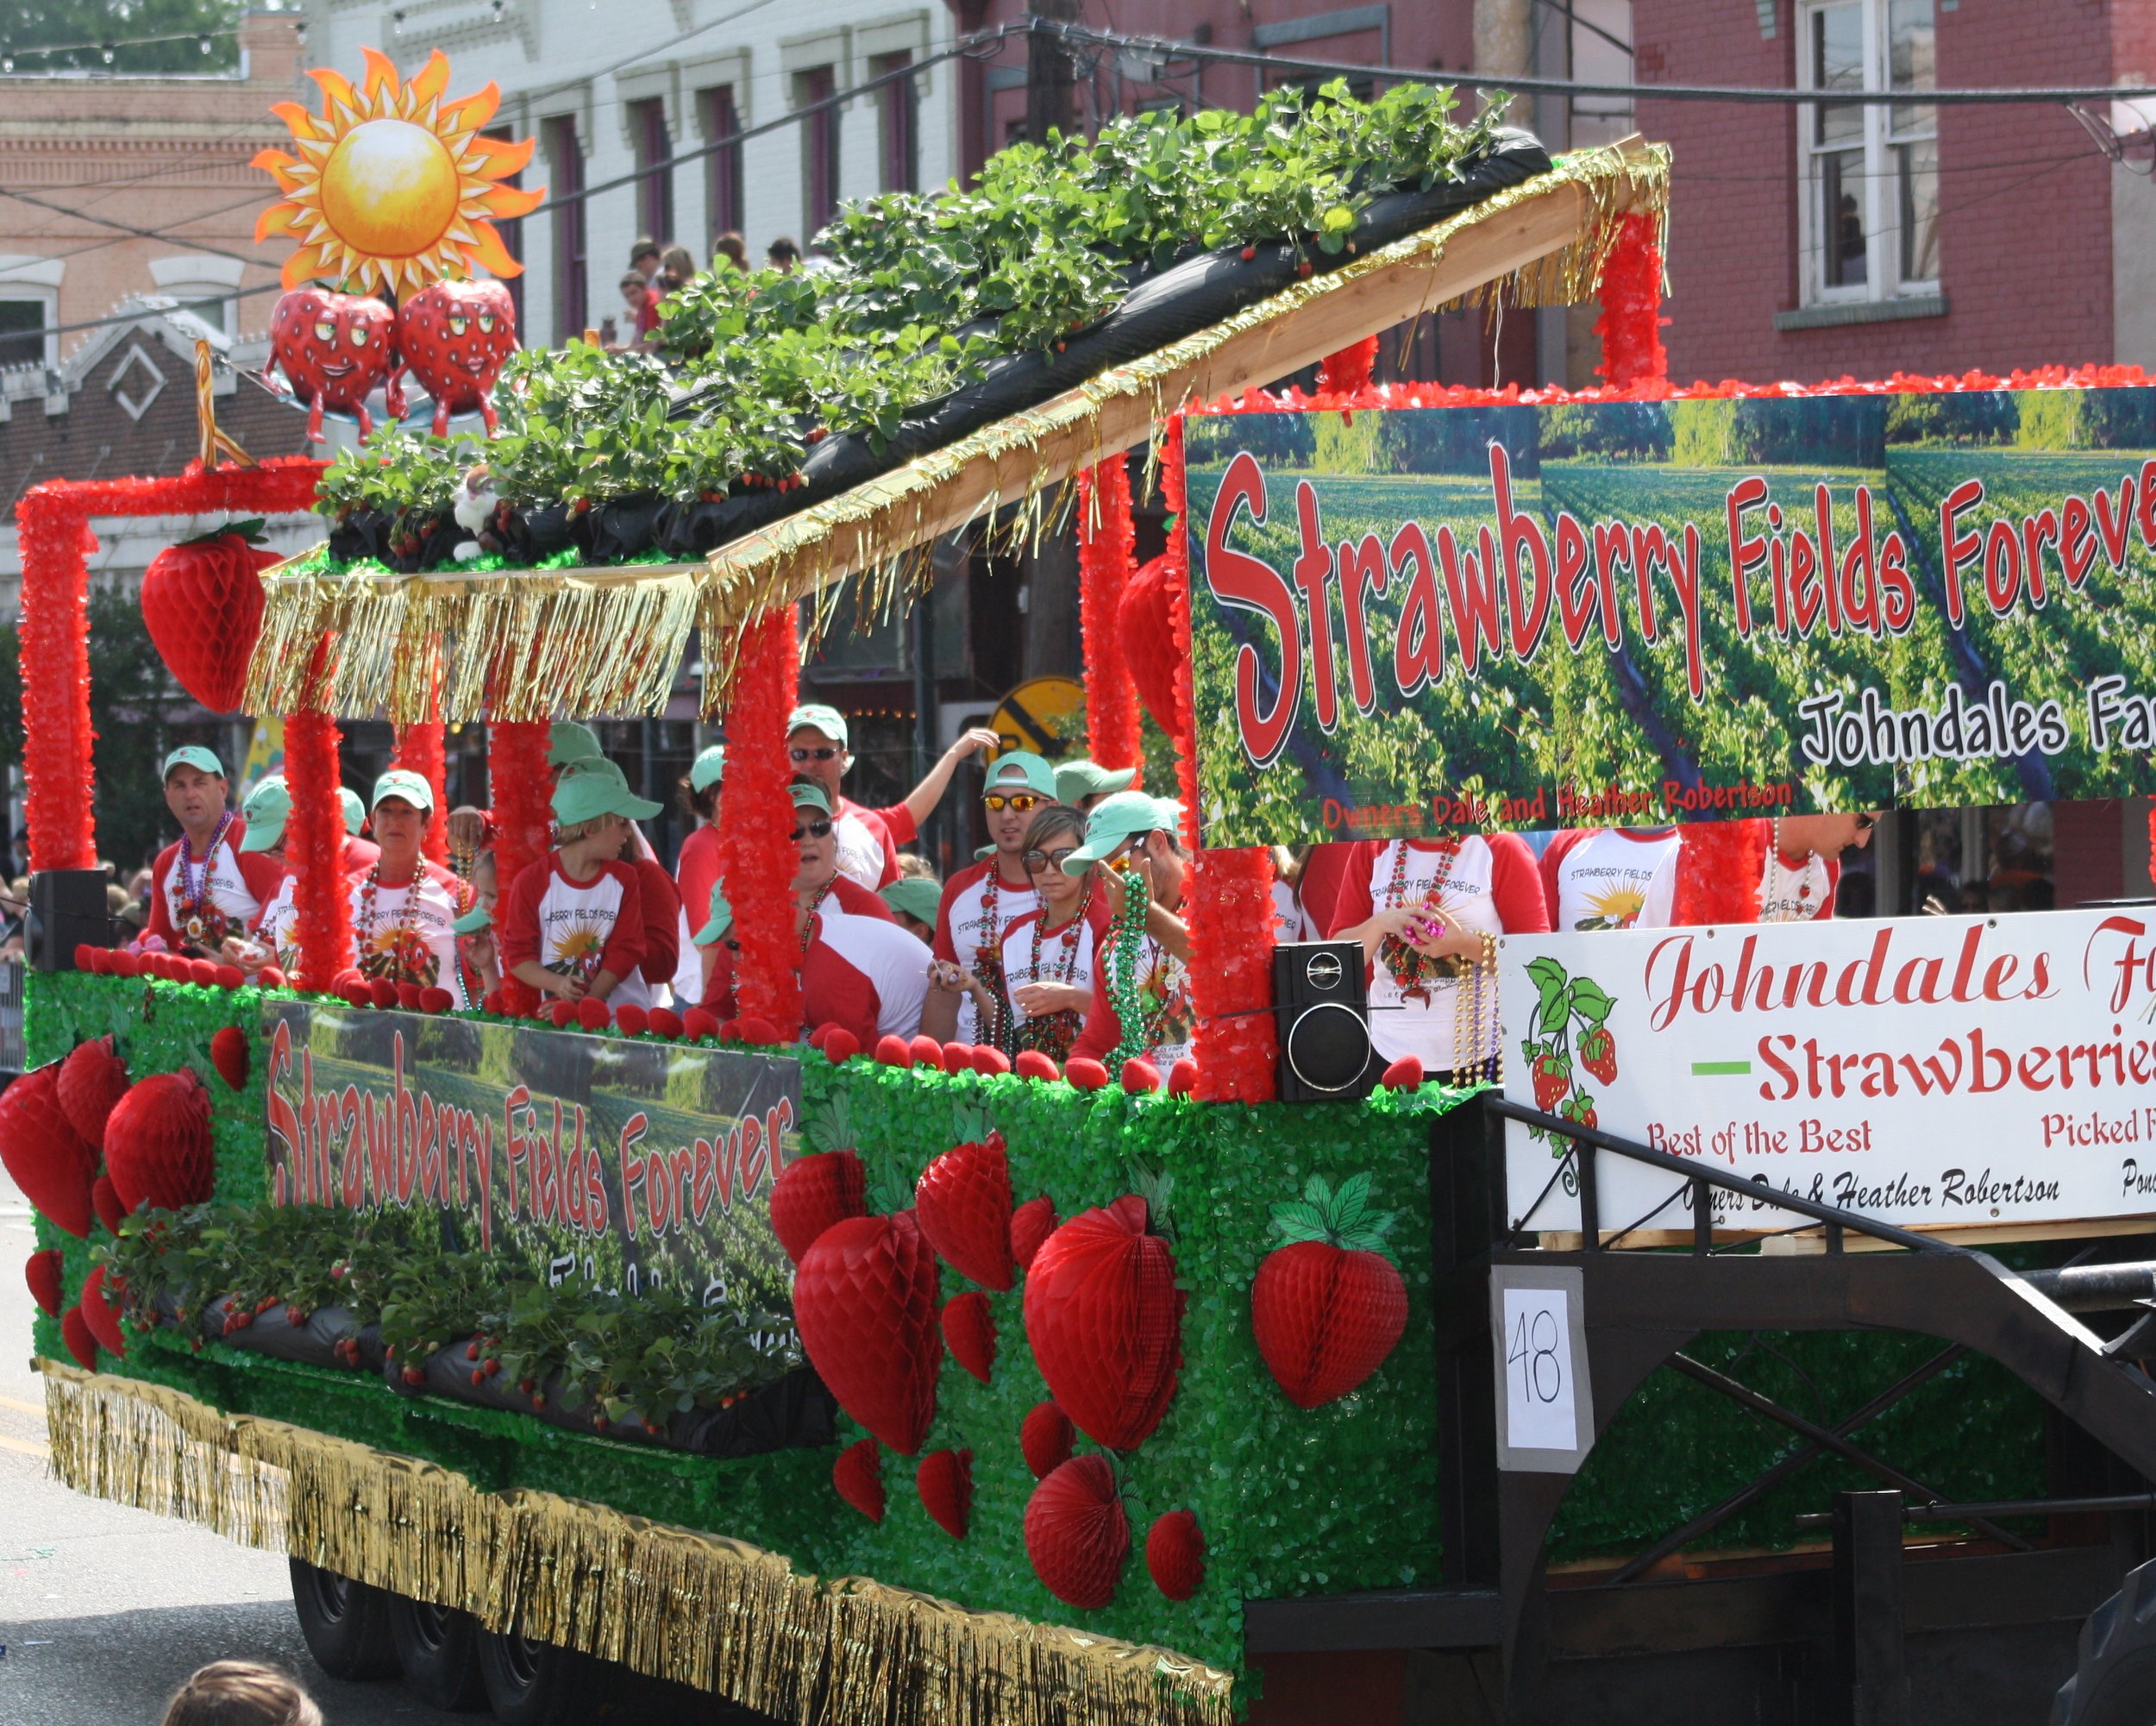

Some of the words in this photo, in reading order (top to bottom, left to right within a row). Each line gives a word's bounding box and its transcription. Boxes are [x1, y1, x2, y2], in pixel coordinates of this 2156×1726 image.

[1206, 442, 1705, 769] Strawberry
[1726, 475, 1916, 642] Fields
[1799, 680, 2067, 767] Johndales
[2088, 675, 2156, 751] Fa
[1322, 797, 1423, 830] Owners
[1432, 788, 1489, 825] Dale
[1499, 786, 1546, 822] and
[1557, 781, 1655, 819] Heather
[1663, 776, 1793, 815] Robertson
[1445, 879, 1481, 895] FOREVER
[1570, 868, 1622, 881] STRAWBERRY
[1624, 868, 1653, 882] FIELDS
[417, 910, 447, 928] FOREVER
[1644, 923, 2061, 1032] Johndales
[2083, 915, 2156, 1014] F
[1757, 1023, 2156, 1102] Strawberrie
[268, 1018, 493, 1252] Strawberry
[505, 1084, 609, 1240] Fields
[620, 1095, 793, 1241] Forever
[1646, 1122, 1702, 1157] Best
[1711, 1121, 1736, 1164] of
[1744, 1120, 1789, 1155] the
[1799, 1119, 1872, 1153] Best
[2040, 1108, 2138, 1148] Picked
[1808, 1172, 1823, 1204] &
[1833, 1171, 1932, 1209] Heather
[1940, 1168, 2060, 1208] Robertson
[2122, 1158, 2156, 1198] Pon
[1507, 1309, 1561, 1403] 48
